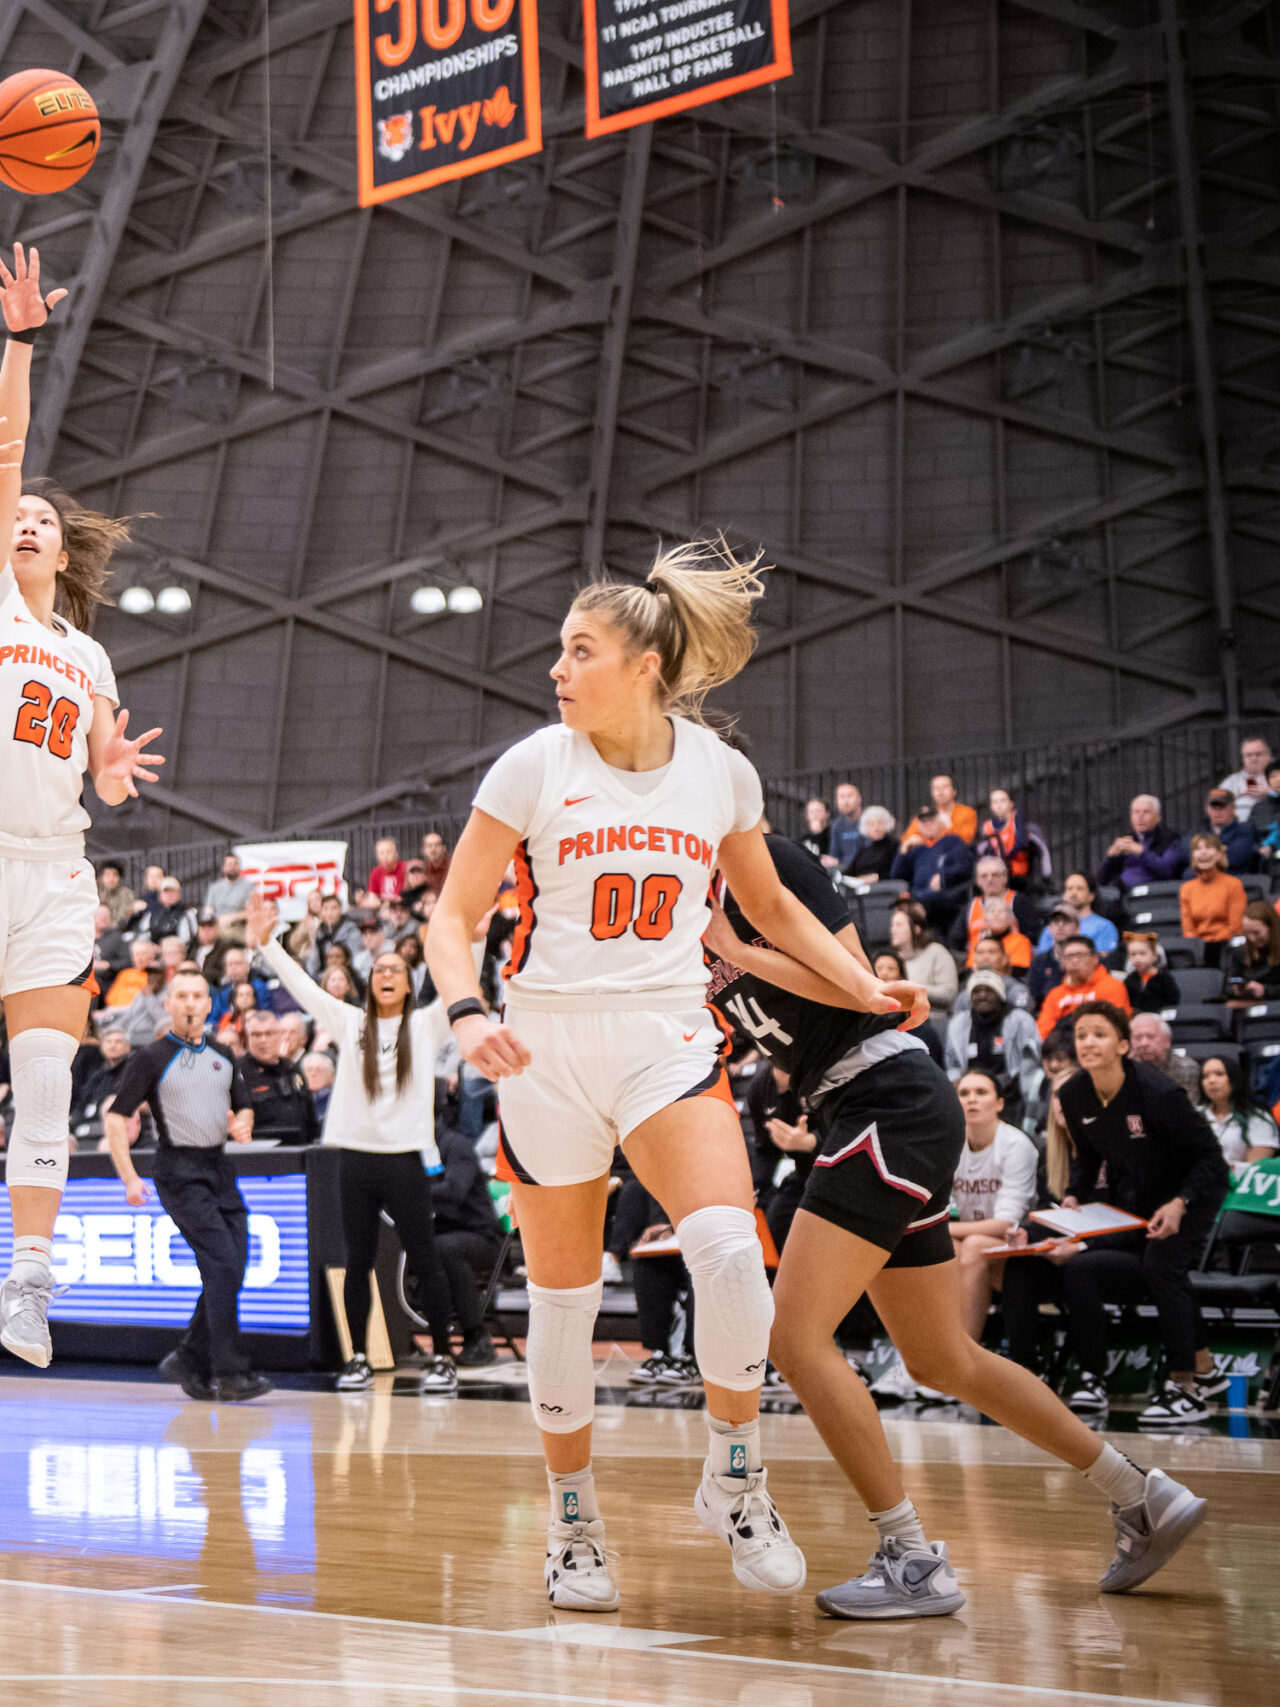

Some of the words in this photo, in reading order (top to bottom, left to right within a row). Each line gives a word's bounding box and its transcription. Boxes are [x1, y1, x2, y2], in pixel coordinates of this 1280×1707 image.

[620, 12, 658, 38] NCAA
[659, 0, 730, 23] TOURN
[630, 36, 663, 60] 1997
[663, 11, 734, 48] INDUCTEE
[375, 34, 518, 100] CHAMPIONSHIPS
[602, 53, 670, 88] NAISMITH
[671, 21, 765, 65] BASKETBALL
[631, 73, 670, 98] HALL
[671, 66, 691, 85] OF
[692, 51, 733, 78] FAME
[38, 92, 93, 116] ELITE
[419, 101, 482, 151] Ivy
[13, 680, 80, 760] 20
[558, 825, 713, 870] PRINCETON
[589, 873, 683, 941] 00
[725, 993, 793, 1056] 14
